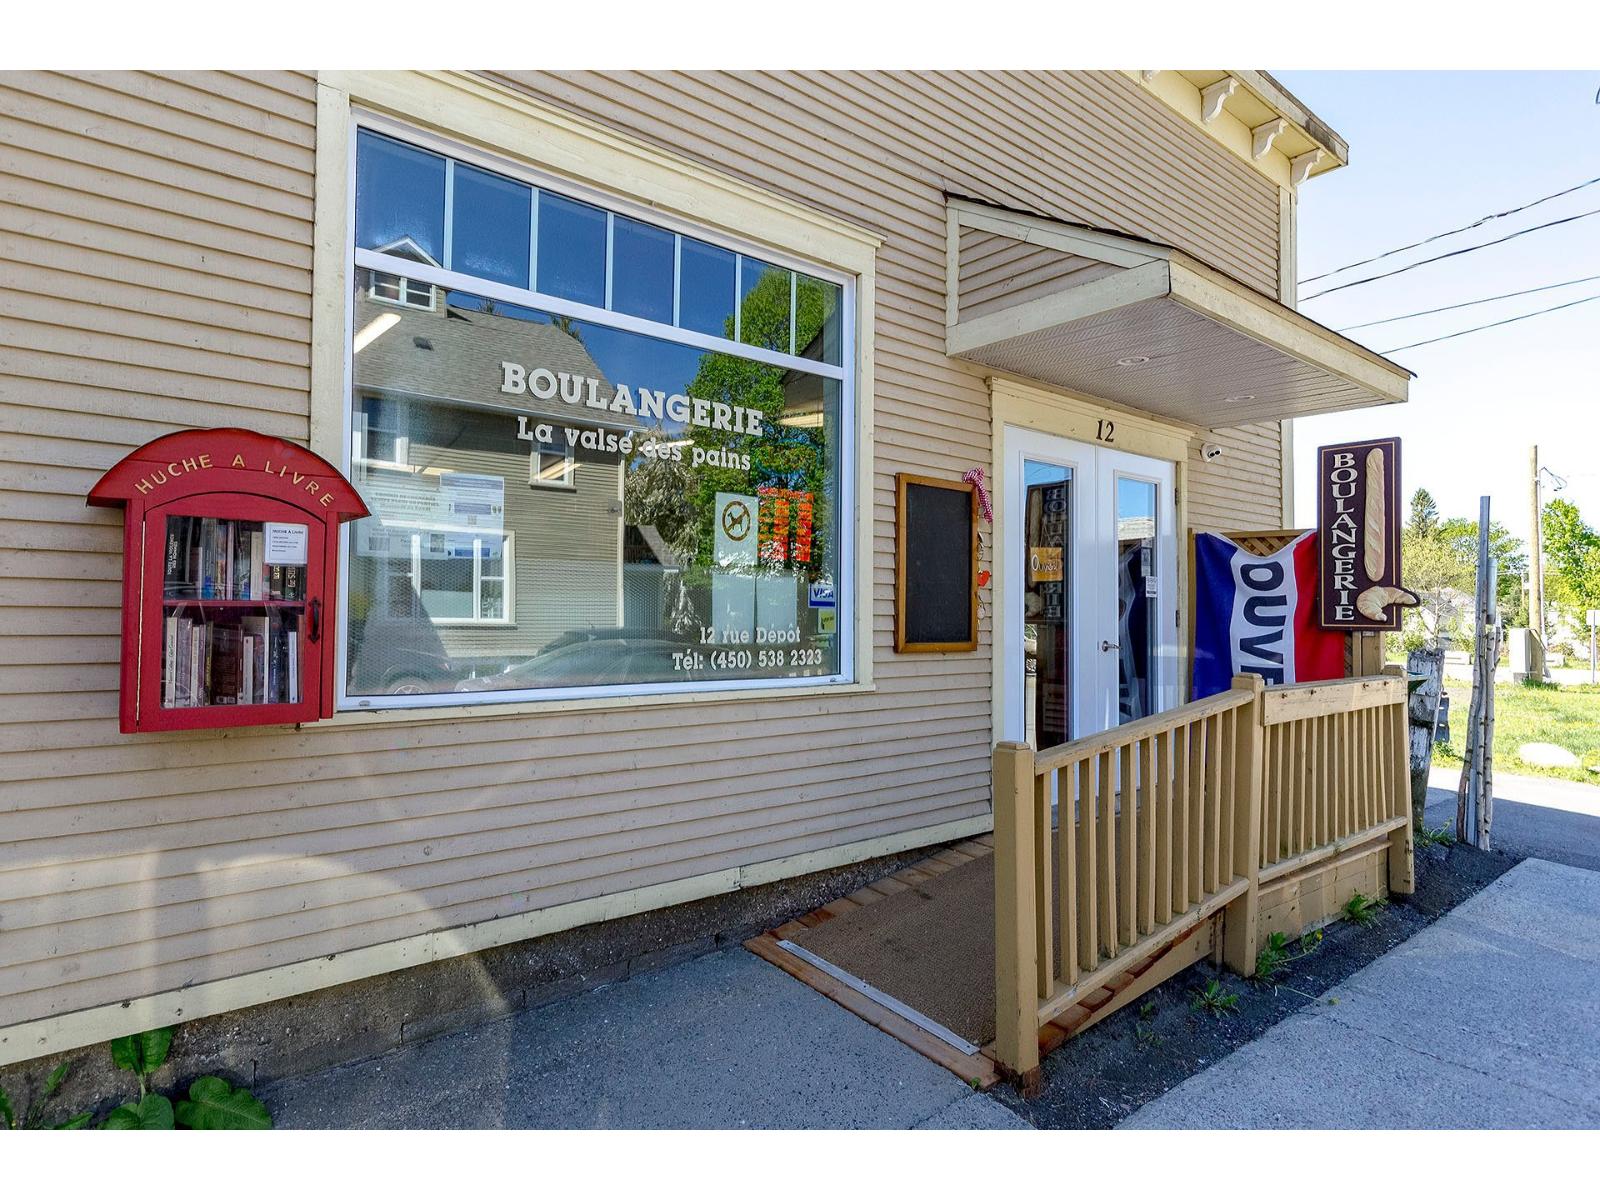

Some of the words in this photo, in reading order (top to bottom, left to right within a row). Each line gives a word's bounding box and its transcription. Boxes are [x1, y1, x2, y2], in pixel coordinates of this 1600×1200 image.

[501, 361, 763, 436] BOULANGERIE
[517, 416, 553, 443] La
[565, 428, 633, 454] valse
[642, 438, 682, 462] des
[692, 446, 751, 471] pains
[1096, 419, 1114, 442] 12
[134, 454, 213, 494] HUCHE
[232, 454, 245, 467] A
[264, 461, 334, 506] LIVRE
[1330, 453, 1358, 621] BOULANGERIE
[813, 587, 834, 598] VISA
[700, 626, 716, 644] 12
[722, 628, 750, 643] rue
[755, 621, 800, 643] Dépôt
[672, 649, 704, 670] Tél:
[710, 650, 752, 669] (450)
[758, 650, 784, 667] 538
[790, 649, 822, 666] 2323
